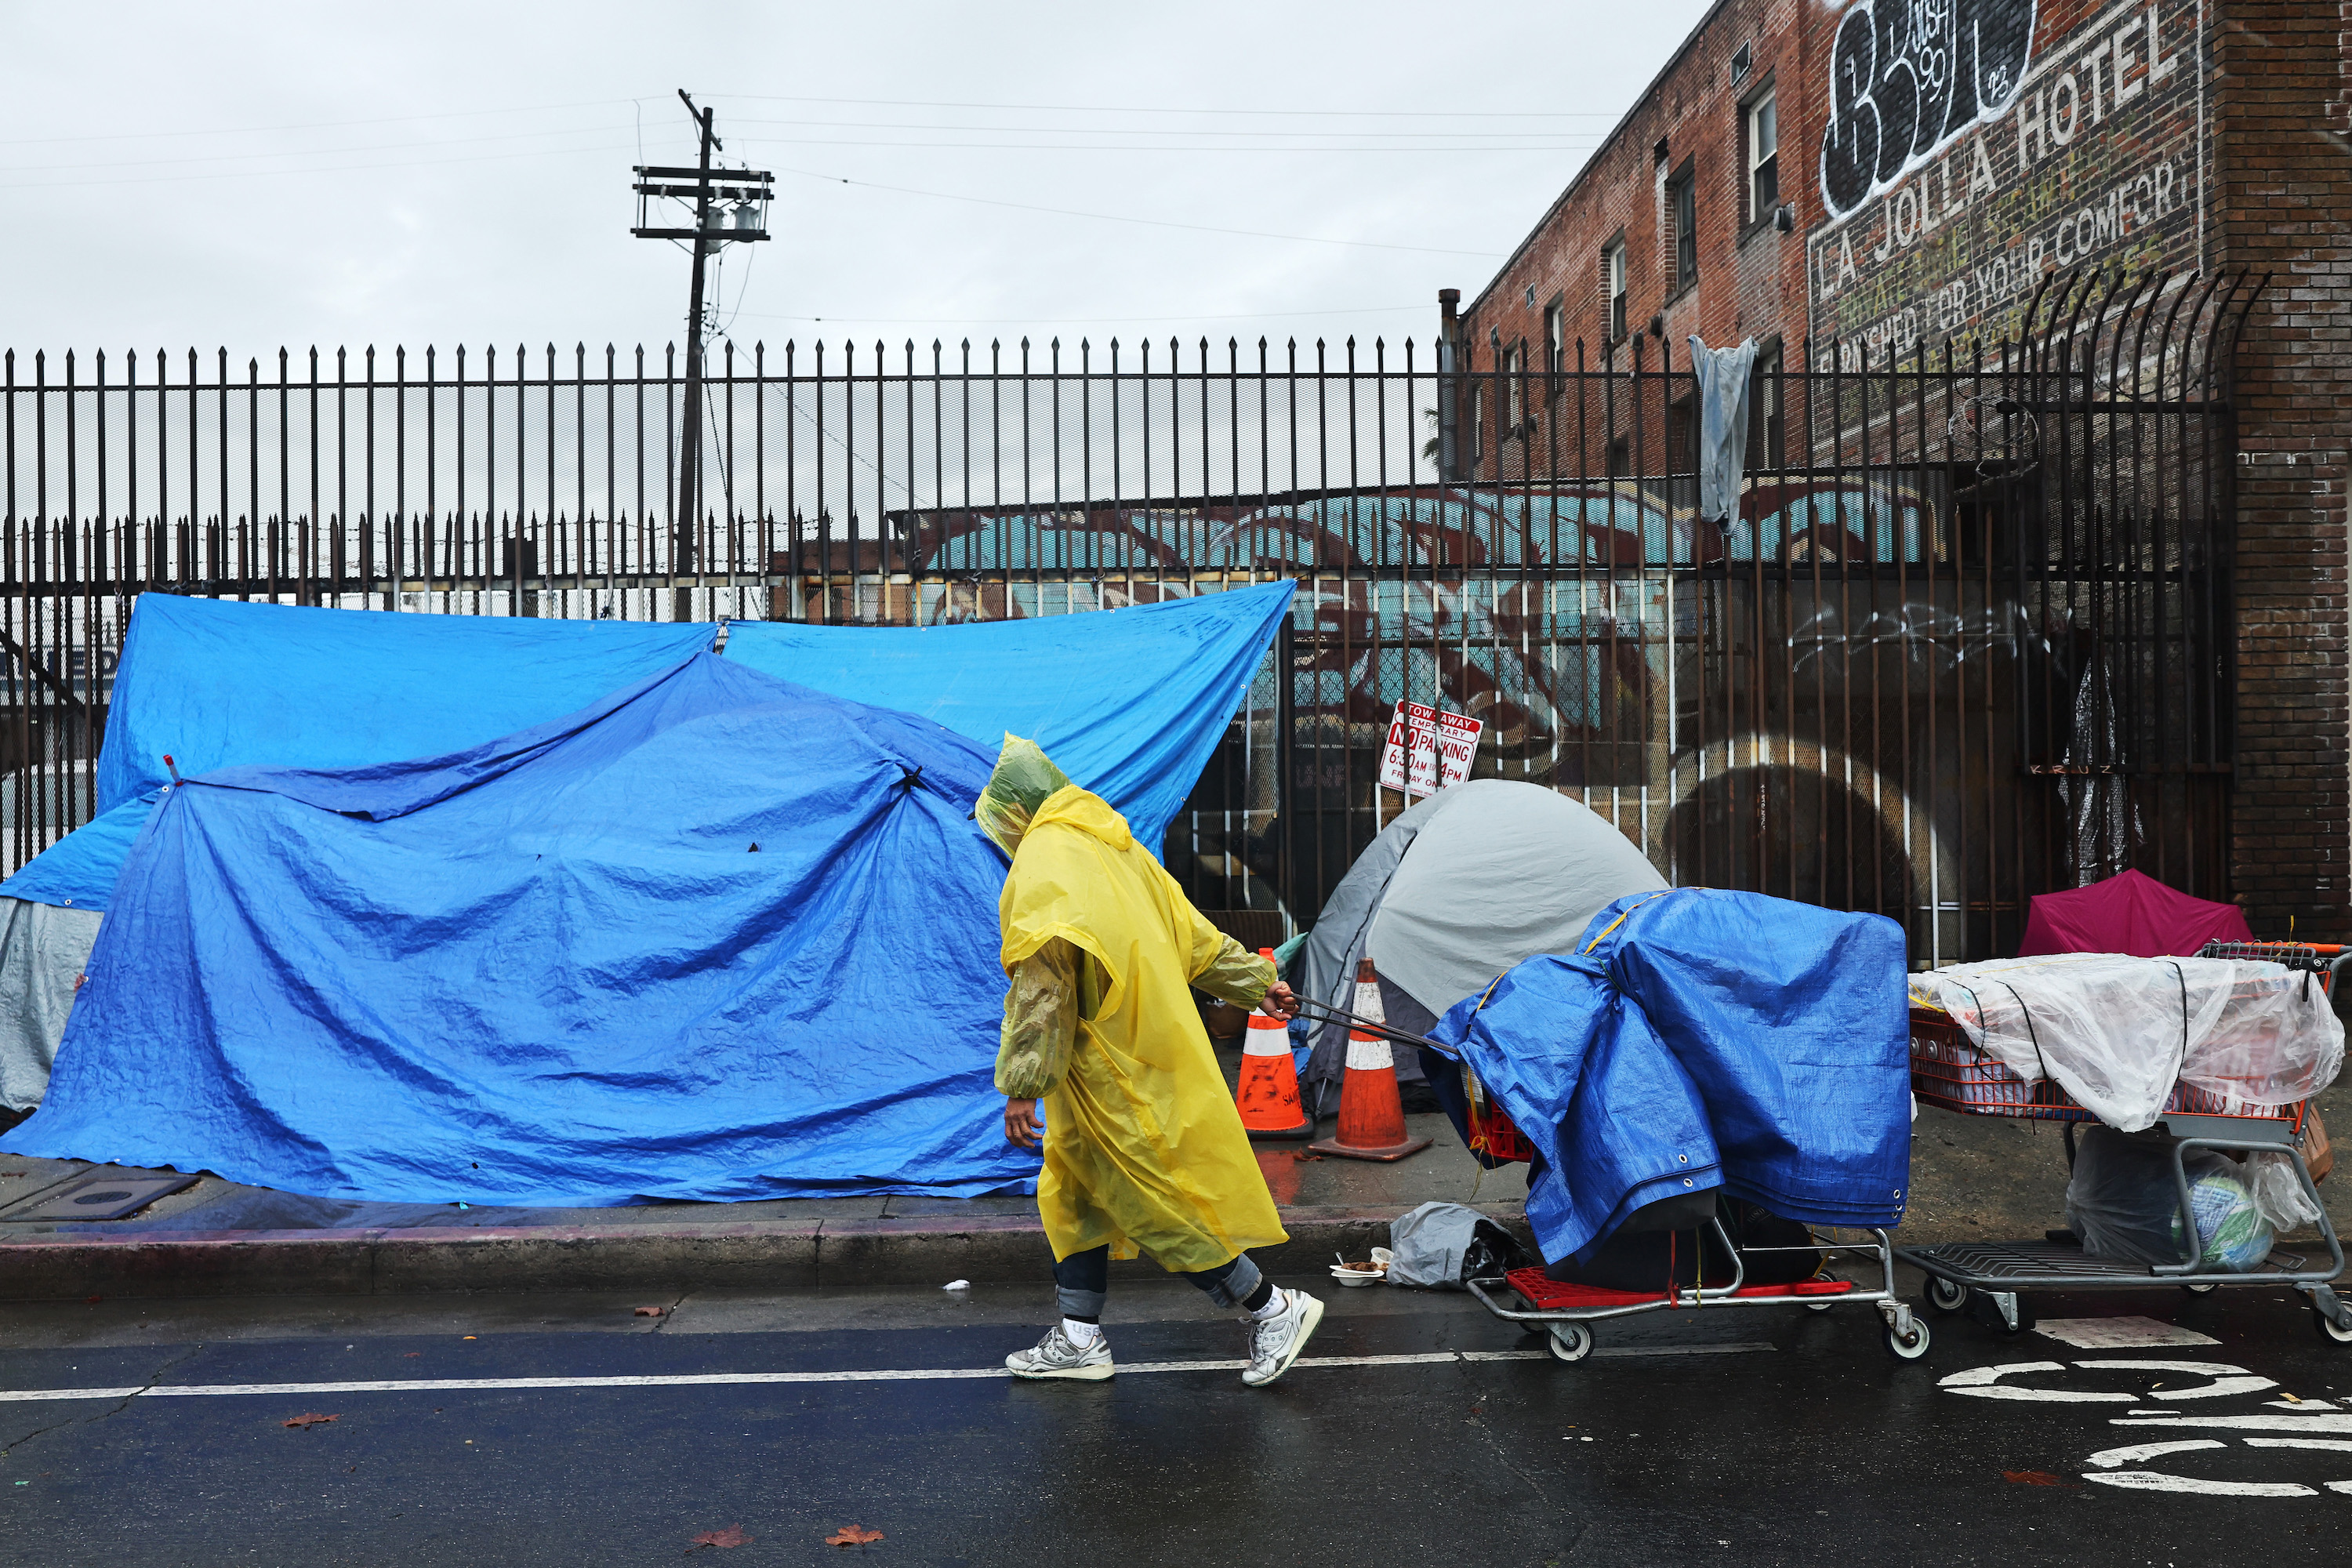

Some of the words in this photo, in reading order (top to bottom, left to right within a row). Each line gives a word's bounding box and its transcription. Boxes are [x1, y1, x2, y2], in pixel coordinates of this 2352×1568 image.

[1818, 228, 1857, 302] LA
[1874, 134, 1996, 263] JOLLA
[2016, 4, 2178, 172] HOTEL
[1975, 237, 2044, 310] YOUR
[1392, 724, 1418, 748] NO
[1408, 717, 1466, 739] EMPOARY
[1425, 779, 1448, 790] ONY
